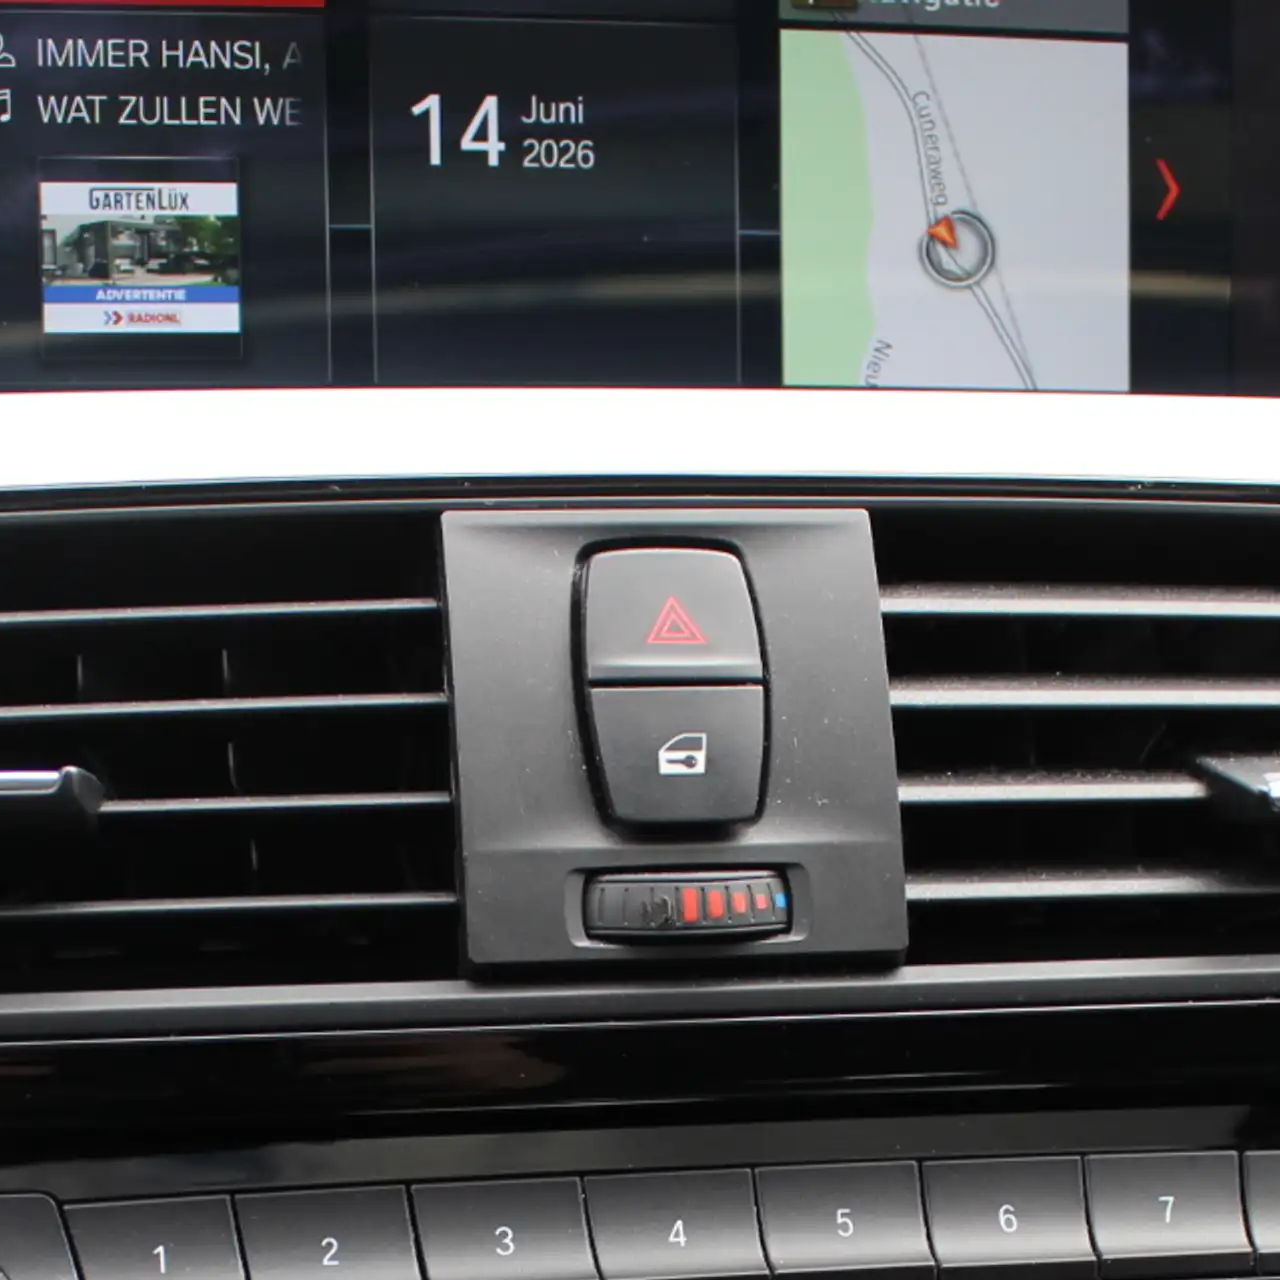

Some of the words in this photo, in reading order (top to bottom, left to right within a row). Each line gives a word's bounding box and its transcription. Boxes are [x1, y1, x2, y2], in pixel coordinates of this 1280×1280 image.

[37, 38, 150, 68] IMMER
[161, 39, 270, 75] HANSI,
[37, 95, 108, 125] WAT
[117, 95, 242, 126] ZULLEN
[253, 96, 303, 127] WE
[520, 94, 585, 125] Juni
[411, 93, 507, 168] 14
[522, 138, 596, 169] 2026
[912, 90, 949, 206] Cuneraweg
[95, 289, 187, 301] ADVERTENTIE
[152, 1245, 167, 1275] 1
[320, 1237, 340, 1268] 2
[494, 1226, 516, 1257] 3
[668, 1220, 689, 1248] 4
[835, 1208, 855, 1239] 5
[997, 1204, 1019, 1234] 6
[1158, 1196, 1177, 1224] 7
